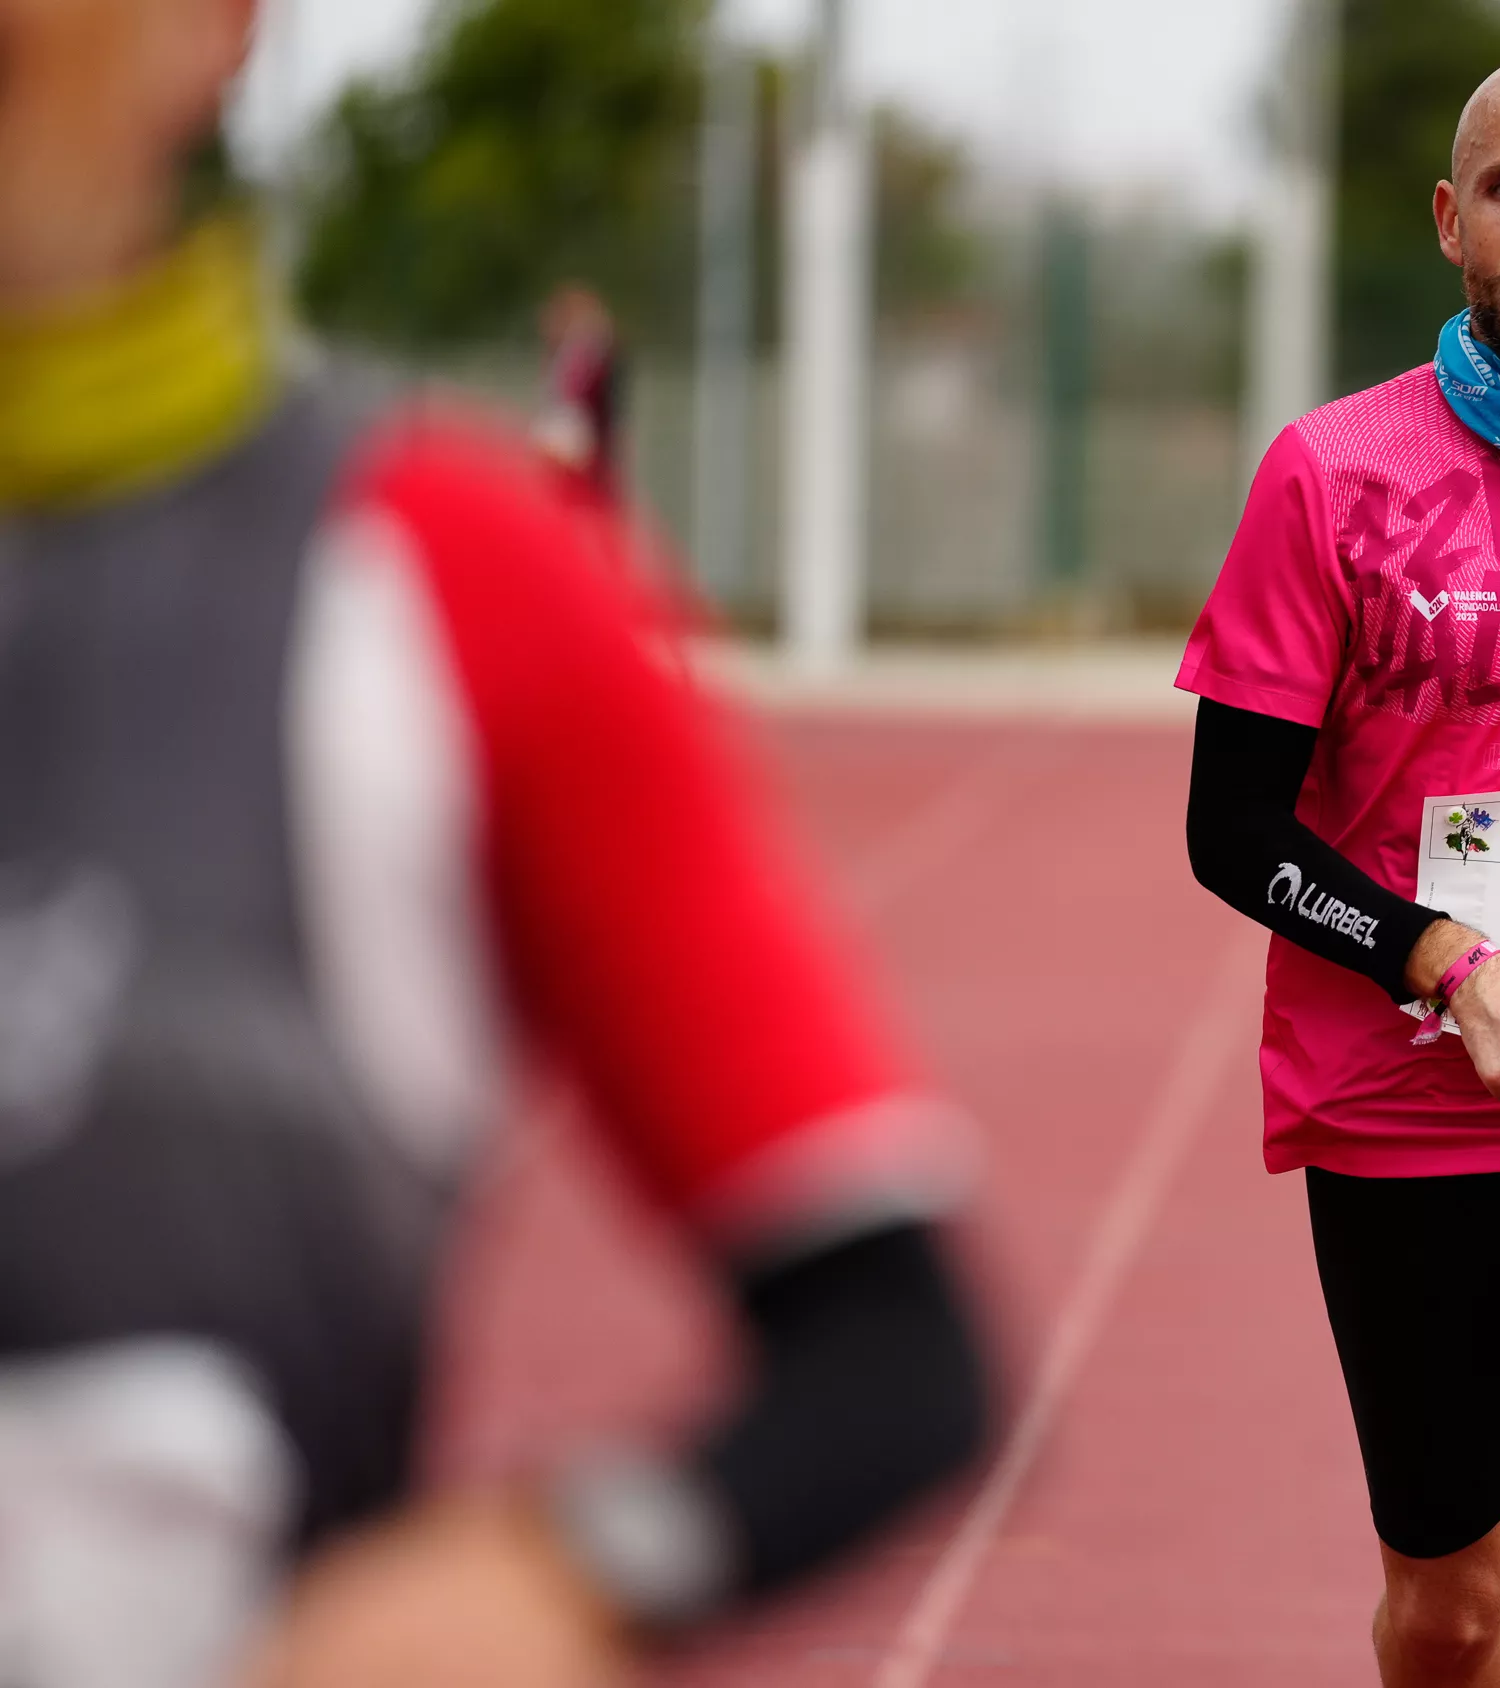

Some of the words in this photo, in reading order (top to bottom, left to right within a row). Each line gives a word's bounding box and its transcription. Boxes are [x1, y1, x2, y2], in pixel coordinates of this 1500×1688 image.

[1453, 590, 1498, 602] VALENCIA
[1428, 597, 1445, 616] 42K
[1454, 602, 1489, 612] TRINIDAD
[1456, 613, 1478, 621] 2023
[1298, 882, 1380, 949] LURBEL
[1468, 947, 1489, 966] 42K
